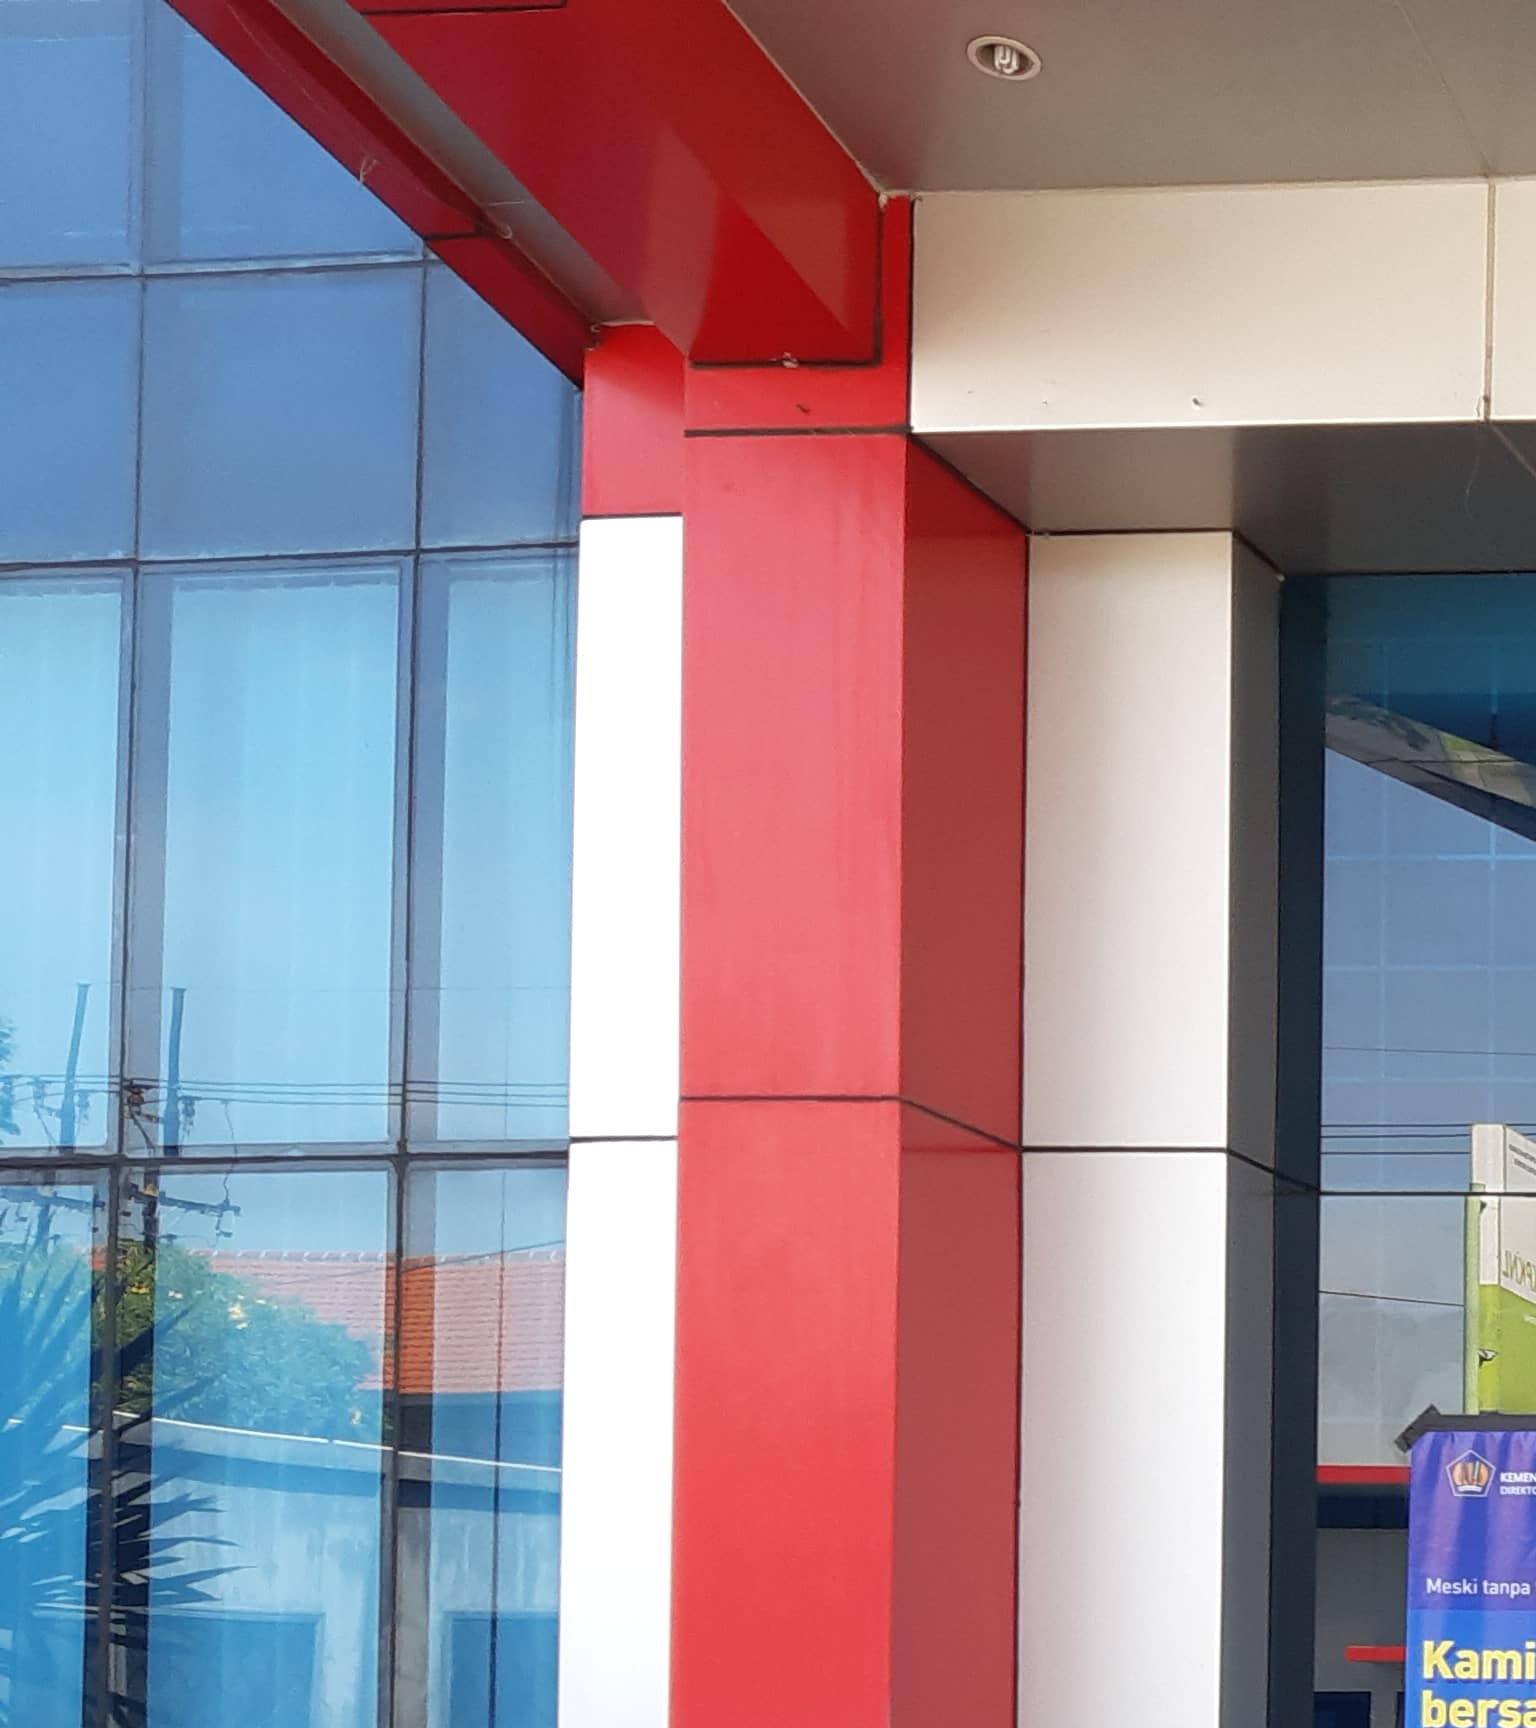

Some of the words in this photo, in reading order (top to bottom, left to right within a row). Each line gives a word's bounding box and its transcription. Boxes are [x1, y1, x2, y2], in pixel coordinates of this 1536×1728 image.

[1425, 1576, 1478, 1596] Meski
[1482, 1578, 1531, 1600] tanpa
[1421, 1640, 1536, 1682] Kami
